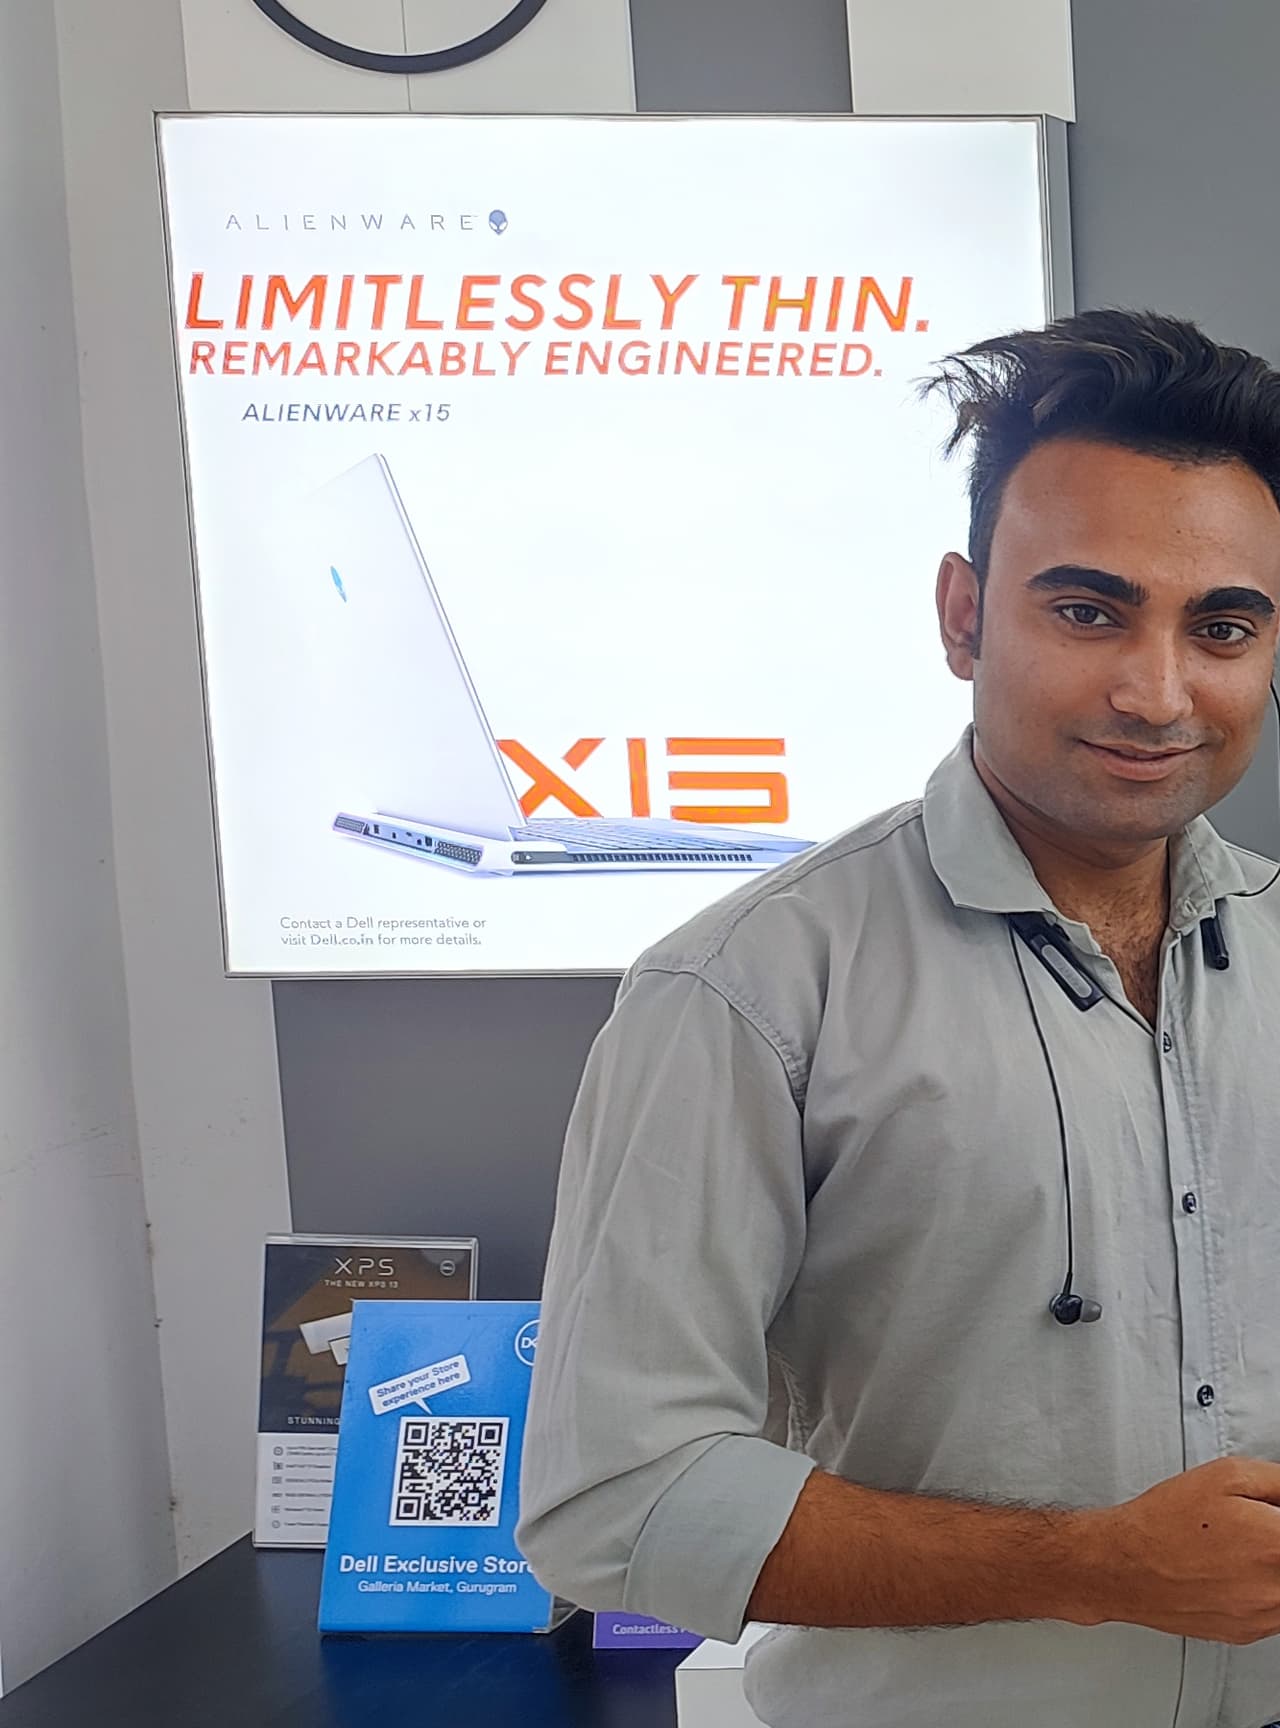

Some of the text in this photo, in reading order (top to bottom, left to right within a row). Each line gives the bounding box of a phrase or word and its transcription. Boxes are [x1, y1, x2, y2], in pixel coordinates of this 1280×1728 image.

[226, 213, 476, 232] ALIENWARE
[184, 272, 930, 333] LIMITLESSLY THIN.
[188, 340, 884, 378] REMARKABLY ENGINEERED.
[242, 402, 451, 422] ALIENWARE x15
[280, 916, 487, 931] Contact a Dell representative or
[281, 933, 307, 945] visit
[311, 933, 374, 946] Dell.co.in
[378, 933, 395, 945] for
[400, 936, 433, 945] more
[334, 1257, 394, 1276] XPS
[325, 1279, 342, 1287] THE
[345, 1280, 365, 1288] NEW
[376, 1361, 460, 1398] Share your Store
[382, 1372, 460, 1407] experience here
[339, 1554, 378, 1573] Dell
[384, 1555, 478, 1573] Exclusive
[358, 1580, 402, 1593] Galleria
[456, 1581, 517, 1596] Gurugram
[612, 1623, 678, 1635] Contactless
